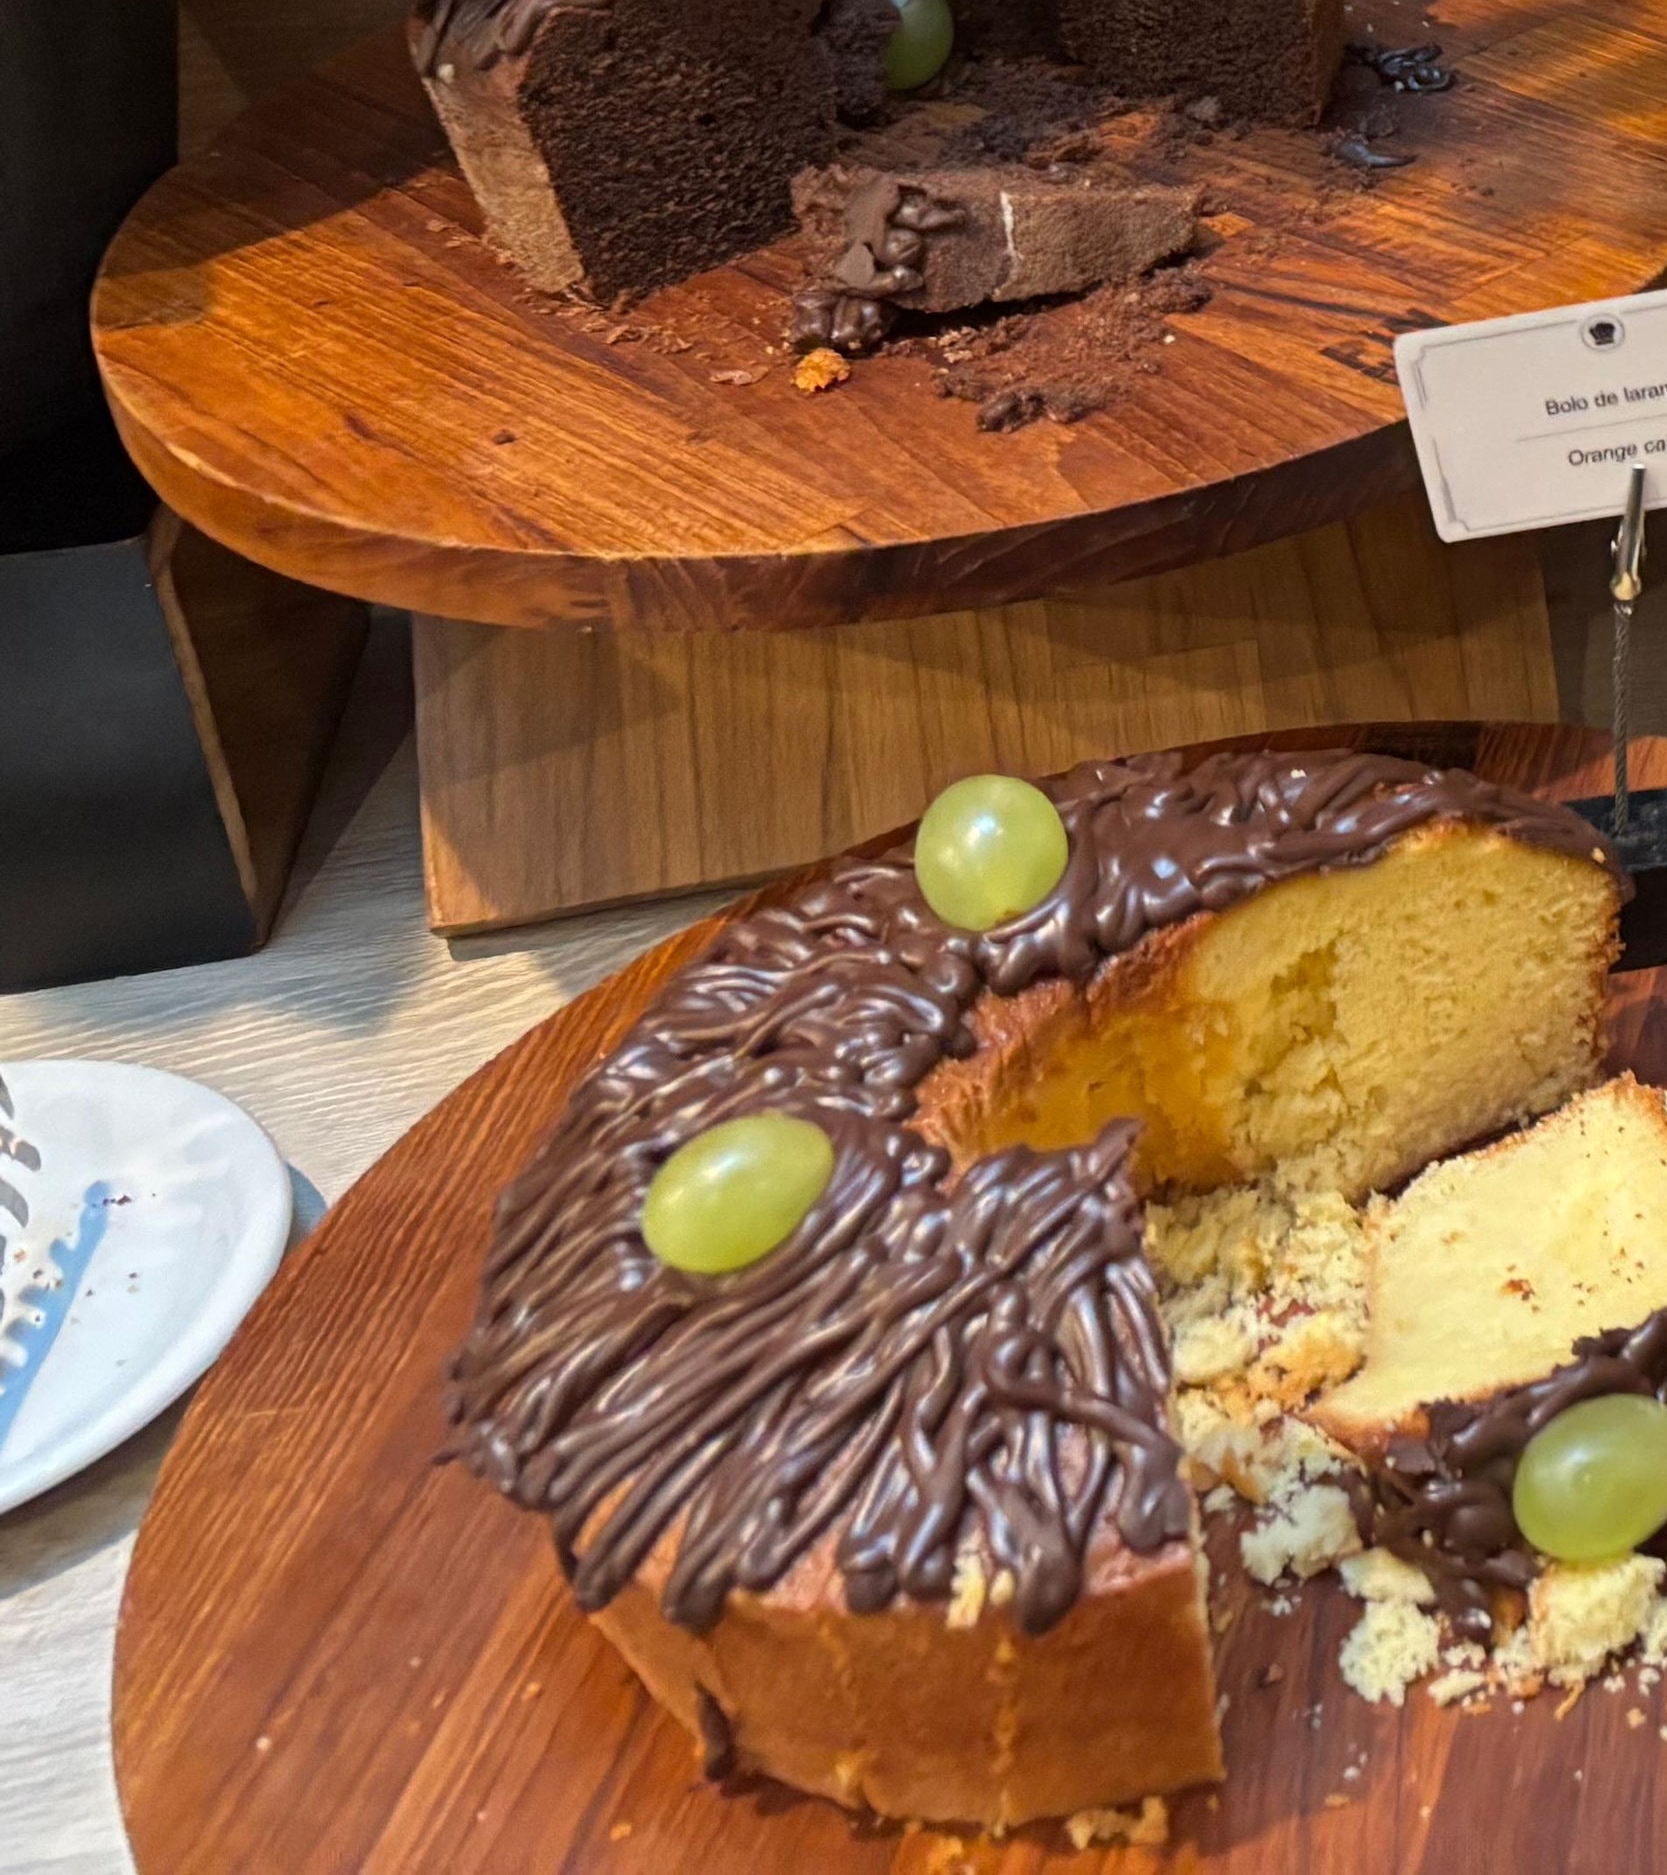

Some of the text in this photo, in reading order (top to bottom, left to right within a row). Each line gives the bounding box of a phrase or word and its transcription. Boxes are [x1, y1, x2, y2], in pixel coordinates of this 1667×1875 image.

[1545, 396, 1589, 417] Bolo
[1594, 389, 1619, 408] de
[1567, 442, 1638, 467] Orange
